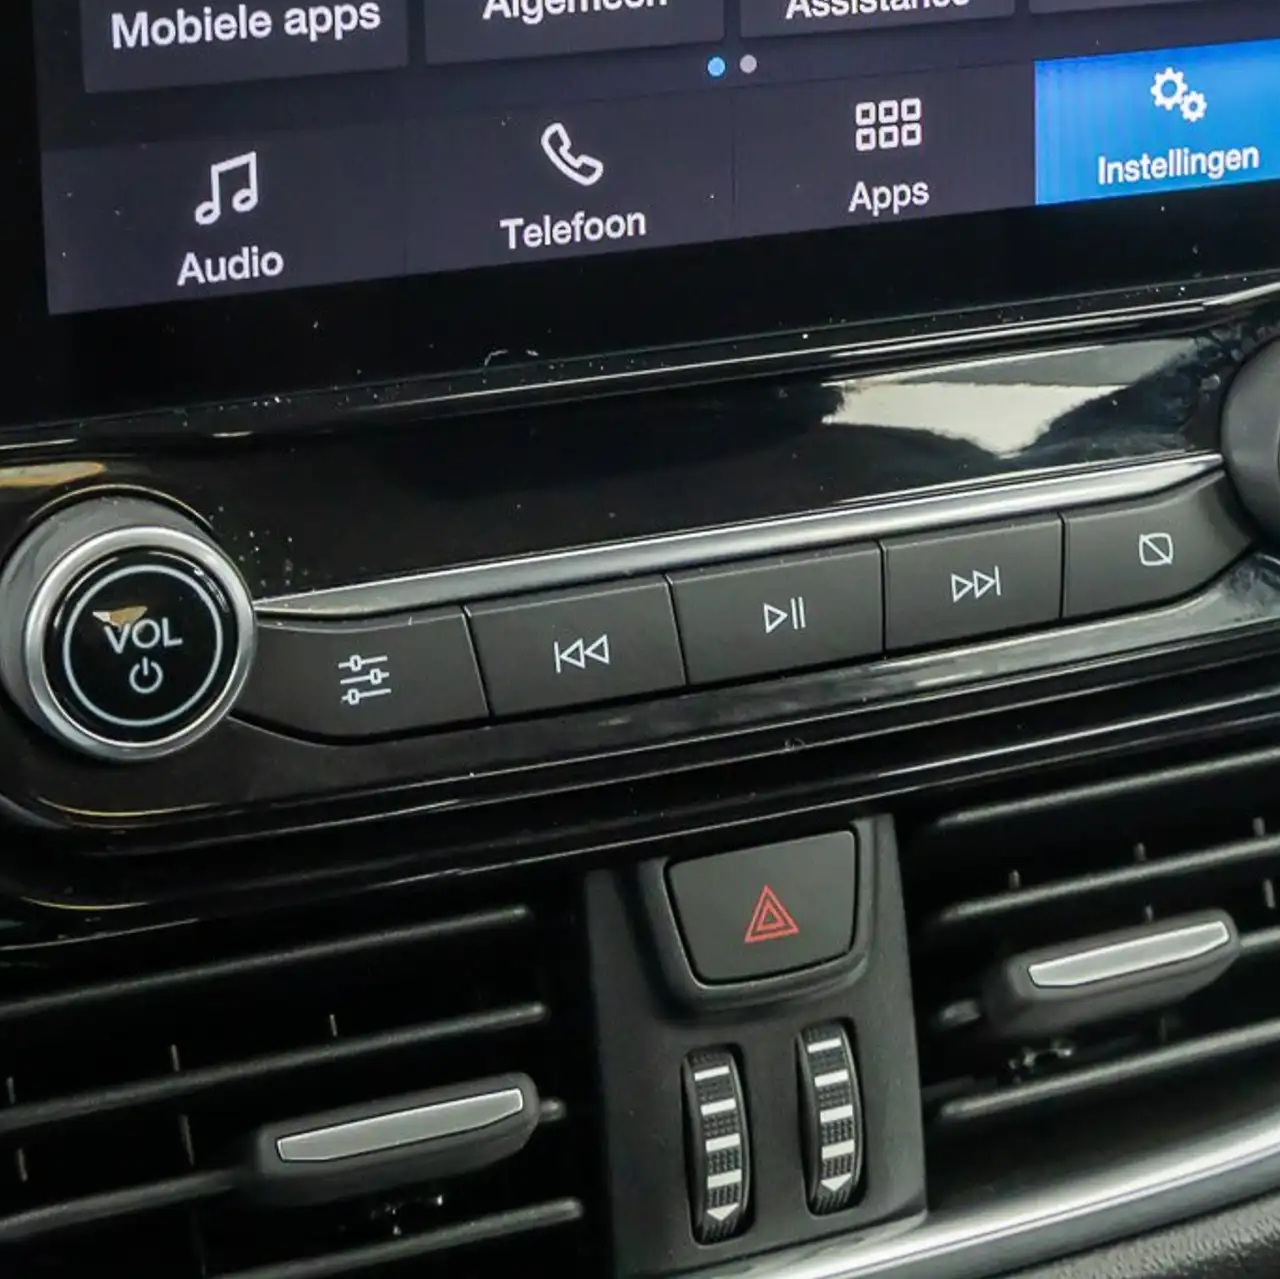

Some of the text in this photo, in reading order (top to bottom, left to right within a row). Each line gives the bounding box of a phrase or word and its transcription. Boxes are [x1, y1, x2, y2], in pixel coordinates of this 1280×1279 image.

[111, 0, 381, 50] Mobiele apps
[1097, 143, 1260, 185] Instellingen
[847, 178, 930, 217] Apps
[499, 210, 646, 250] Telefoon
[177, 246, 284, 287] Audio
[104, 618, 183, 655] VOL
